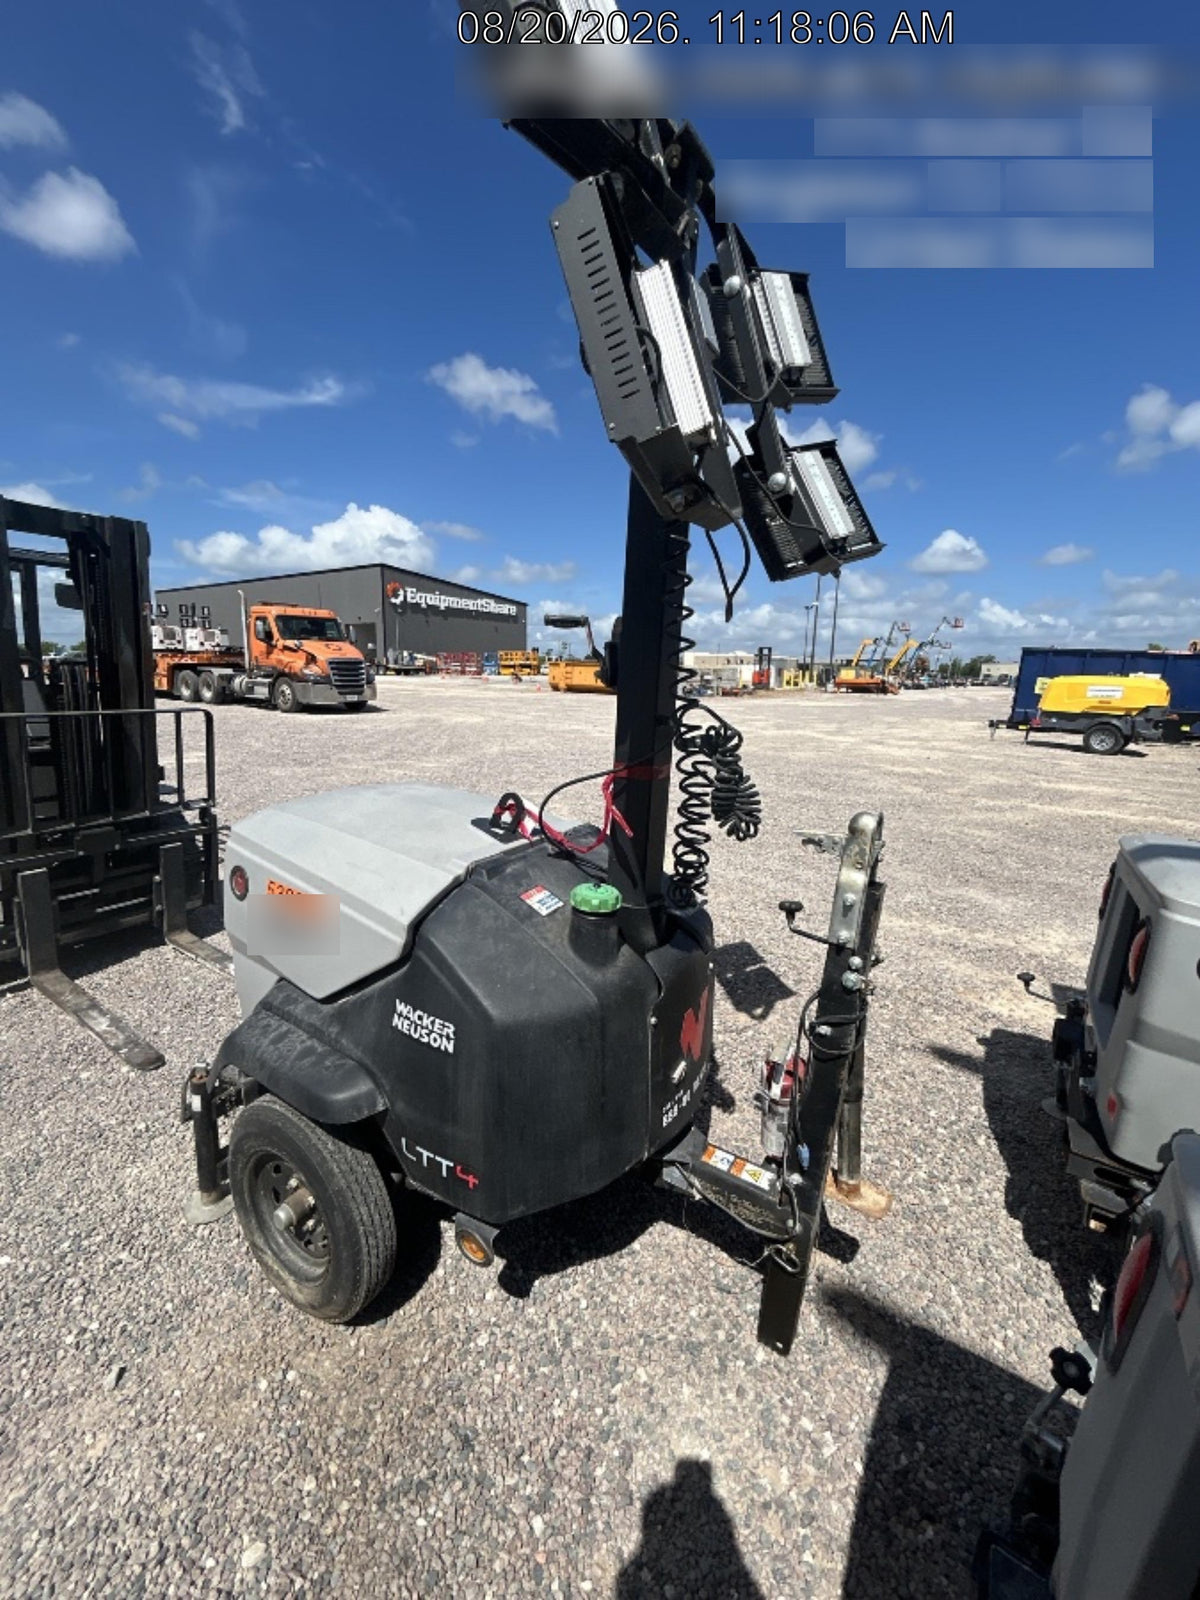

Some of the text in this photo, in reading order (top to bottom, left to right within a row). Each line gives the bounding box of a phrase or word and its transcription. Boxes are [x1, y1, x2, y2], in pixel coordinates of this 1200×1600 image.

[405, 587, 517, 616] EquipmentShare
[392, 1012, 455, 1054] NEUSON
[395, 998, 456, 1039] WACKER
[401, 1136, 479, 1190] LTT4
